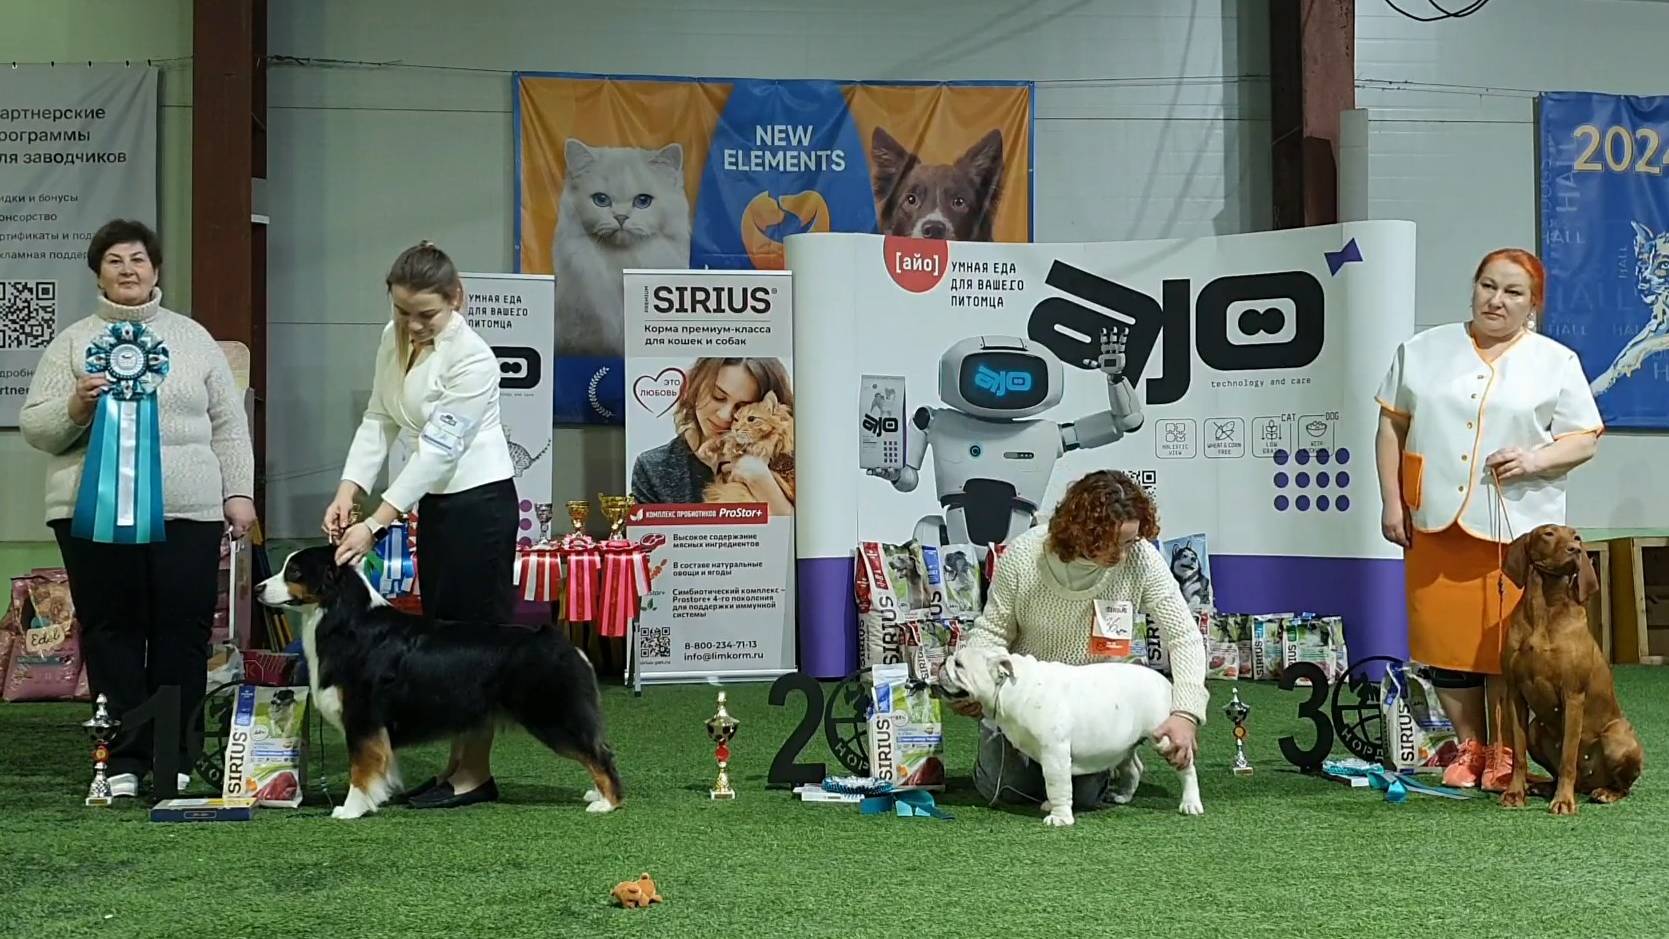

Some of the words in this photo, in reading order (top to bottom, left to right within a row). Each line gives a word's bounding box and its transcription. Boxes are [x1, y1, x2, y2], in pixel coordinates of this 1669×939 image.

[0, 107, 106, 122] артнерские
[0, 130, 91, 145] рограммы
[756, 124, 813, 146] NEW
[1573, 124, 1669, 175] 202
[0, 152, 18, 164] ля
[23, 152, 127, 165] заводчиков
[724, 149, 846, 172] ELEMENTS
[0, 194, 26, 204] дки
[39, 193, 79, 204] бонусы
[0, 213, 57, 223] онсорство
[0, 232, 59, 242] ртификаты
[73, 233, 96, 241] под
[0, 251, 46, 260] кламная
[50, 251, 87, 261] поддер
[896, 252, 939, 276] [айо]
[951, 261, 989, 274] УМНАЯ
[993, 262, 1017, 276] ЕДА
[950, 278, 973, 291] ДЛЯ
[978, 279, 1024, 291] ВАШЕГО
[468, 294, 500, 303] УМНАЯ
[503, 295, 523, 305] ЕДА
[653, 286, 771, 314] SIRIUS
[951, 295, 1004, 309] ПИТОМЦА
[468, 307, 487, 316] ДЛЯ
[490, 307, 528, 317] ВАШЕГО
[468, 319, 513, 330] ПИТОМЦА
[644, 324, 679, 334] Корма
[681, 325, 771, 335] премиум-класса
[1612, 323, 1640, 336] HAL
[644, 338, 665, 346] для
[668, 337, 703, 346] кошек
[715, 336, 747, 346] собак
[0, 368, 33, 378] дробн
[663, 378, 681, 387] ЭТО
[1211, 378, 1264, 388] technology
[1270, 377, 1286, 386] and
[1291, 376, 1311, 385] care
[0, 386, 30, 396] rtner
[640, 388, 678, 397] ЛЮБОВЬ
[1281, 413, 1297, 422] CAT
[1325, 411, 1340, 421] DOG
[646, 510, 676, 519] КОМПЛЕКС
[676, 509, 717, 519] ПРОБИОТИКОВ
[719, 507, 763, 518] ProStor+
[673, 534, 707, 542] Высокое
[709, 533, 758, 543] содержание
[673, 541, 704, 549] мясных
[704, 541, 760, 550] ингредиентов
[681, 561, 710, 569] составе
[711, 560, 763, 570] натуральные
[673, 570, 700, 578] овощи
[707, 569, 732, 578] ягоды
[672, 588, 739, 597] Симбиотический
[741, 587, 779, 596] комплекс
[731, 595, 774, 603] поколения
[672, 604, 687, 612] для
[688, 603, 734, 612] поддержки
[735, 601, 776, 611] иммунной
[672, 611, 707, 619] системы
[879, 596, 900, 665] SIRIUS
[684, 640, 757, 650] 8-800-234-71-13
[683, 652, 764, 662] info@limkorm.ru
[1278, 661, 1334, 769] 3
[768, 671, 826, 784] 2
[1398, 703, 1415, 762] SIRIUS
[876, 718, 893, 780] SIRIUS
[228, 731, 248, 794] SIRIUS
